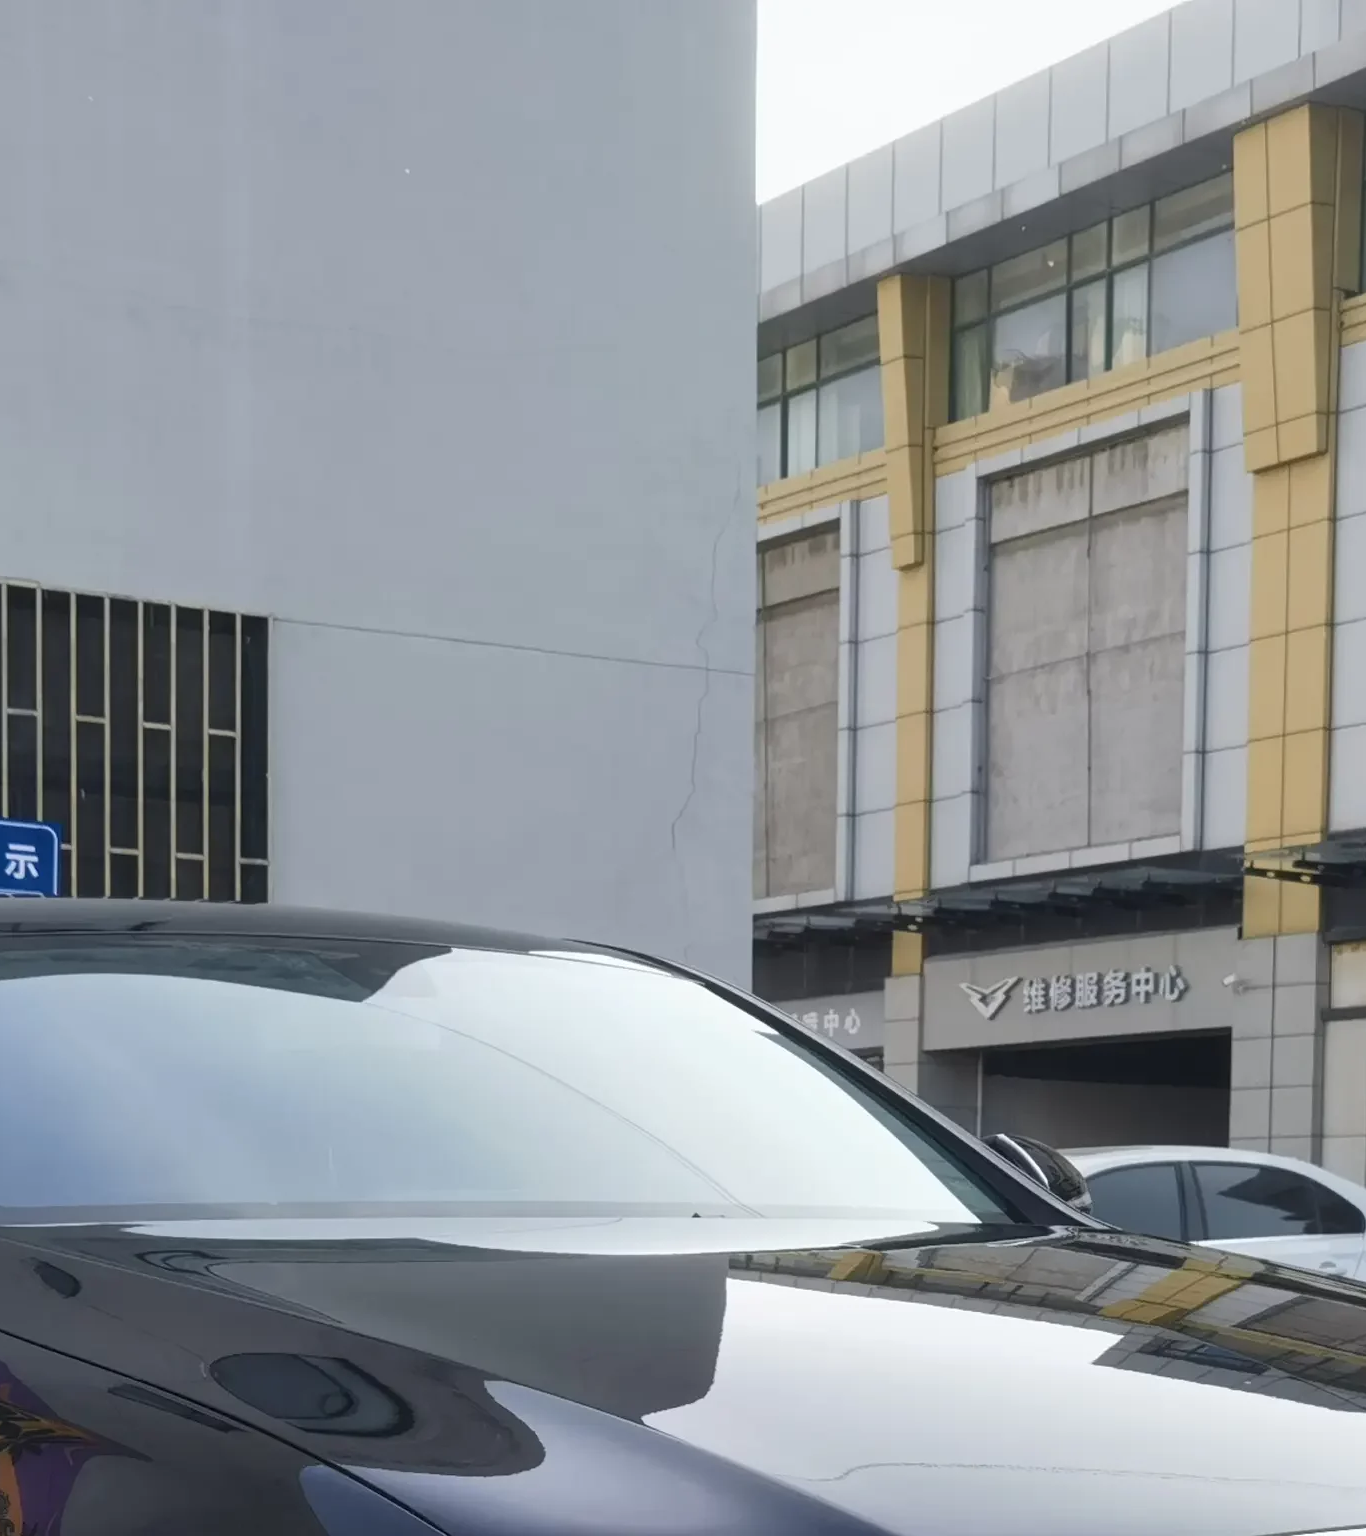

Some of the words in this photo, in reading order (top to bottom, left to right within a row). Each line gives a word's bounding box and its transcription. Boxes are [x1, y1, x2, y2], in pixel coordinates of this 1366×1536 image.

[1022, 964, 1186, 1014] 维修服务中心
[792, 1008, 862, 1037] 中心
